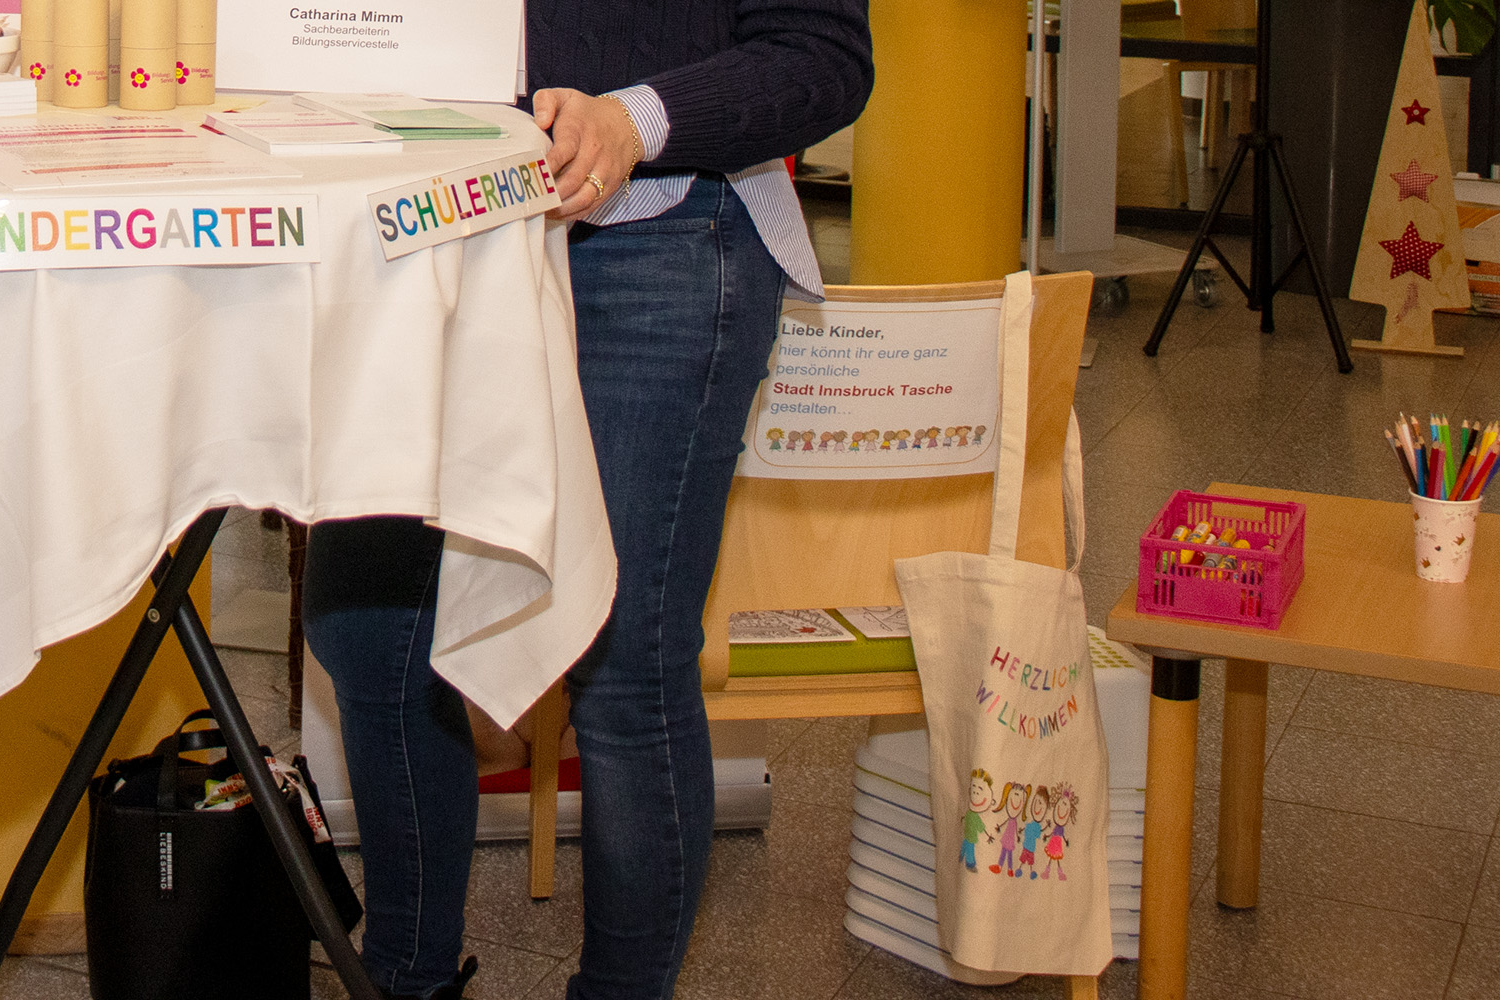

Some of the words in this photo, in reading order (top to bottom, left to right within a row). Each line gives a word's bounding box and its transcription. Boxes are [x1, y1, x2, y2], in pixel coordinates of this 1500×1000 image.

[289, 7, 357, 22] Catharina
[361, 10, 404, 23] Mimm
[303, 23, 390, 36] Sachbearbeiterin
[292, 36, 399, 49] Bildungsservicestelle
[375, 158, 556, 242] SCHÜLERHORTE
[781, 322, 825, 338] Liebe
[829, 325, 885, 341] Kinder,
[778, 343, 807, 358] hier
[810, 344, 852, 359] könnt
[855, 346, 874, 359] ihr
[877, 347, 910, 360] eure
[913, 346, 948, 362] ganz
[775, 363, 860, 379] persönliche
[772, 382, 815, 397] Stadt
[818, 384, 896, 398] Innsbruck
[900, 382, 953, 397] Tasche
[989, 645, 1078, 691] HERZLICH
[975, 679, 1079, 739] WILLKOMMEN
